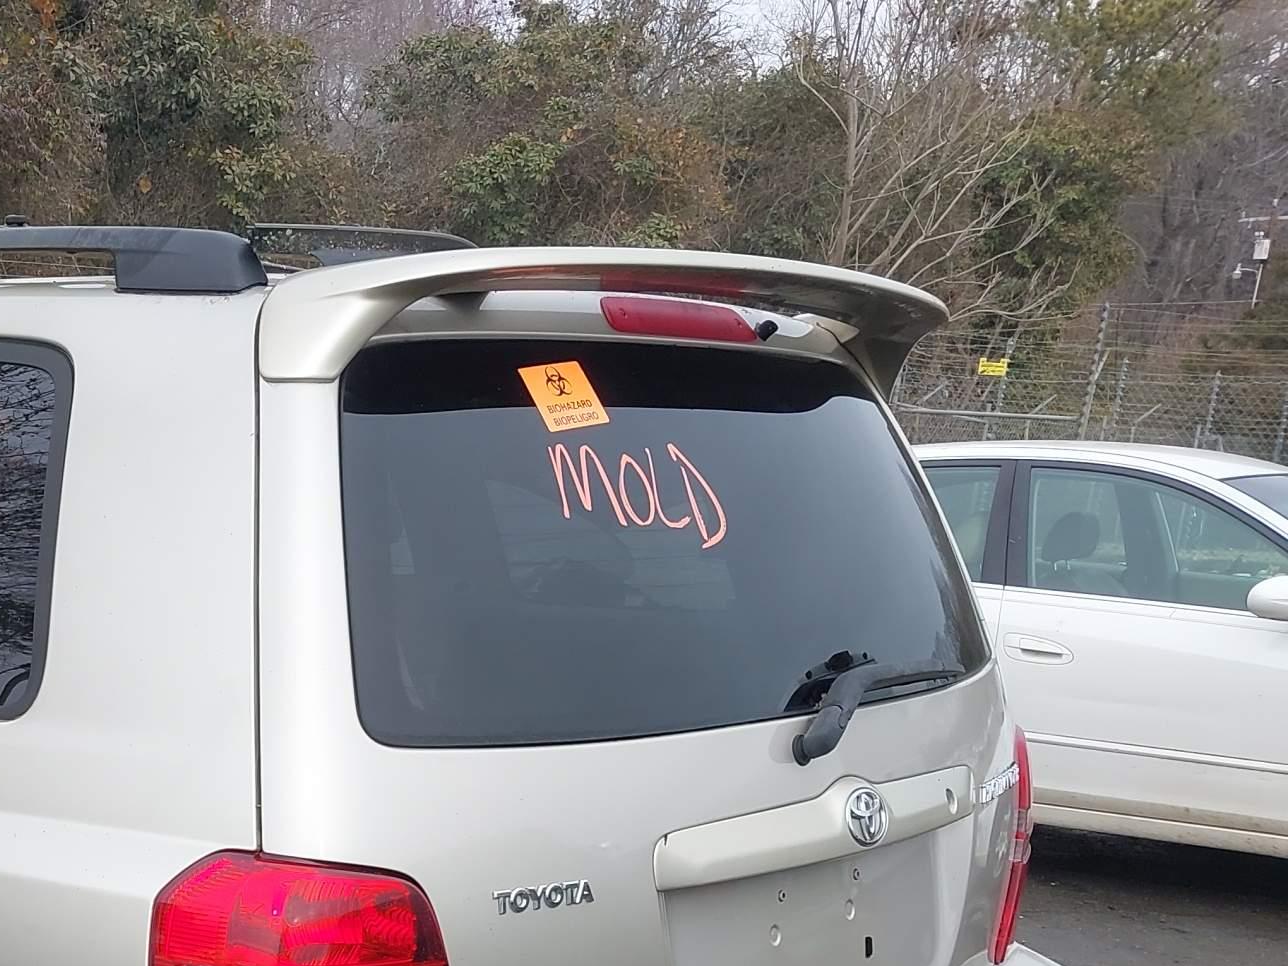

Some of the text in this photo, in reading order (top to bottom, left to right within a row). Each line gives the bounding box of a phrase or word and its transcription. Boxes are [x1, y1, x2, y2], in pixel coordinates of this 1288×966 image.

[546, 399, 593, 414] BIOHAZARD
[553, 411, 599, 426] BIOPELIGRO
[546, 442, 727, 550] MOLD
[492, 879, 595, 915] TOYOTA
